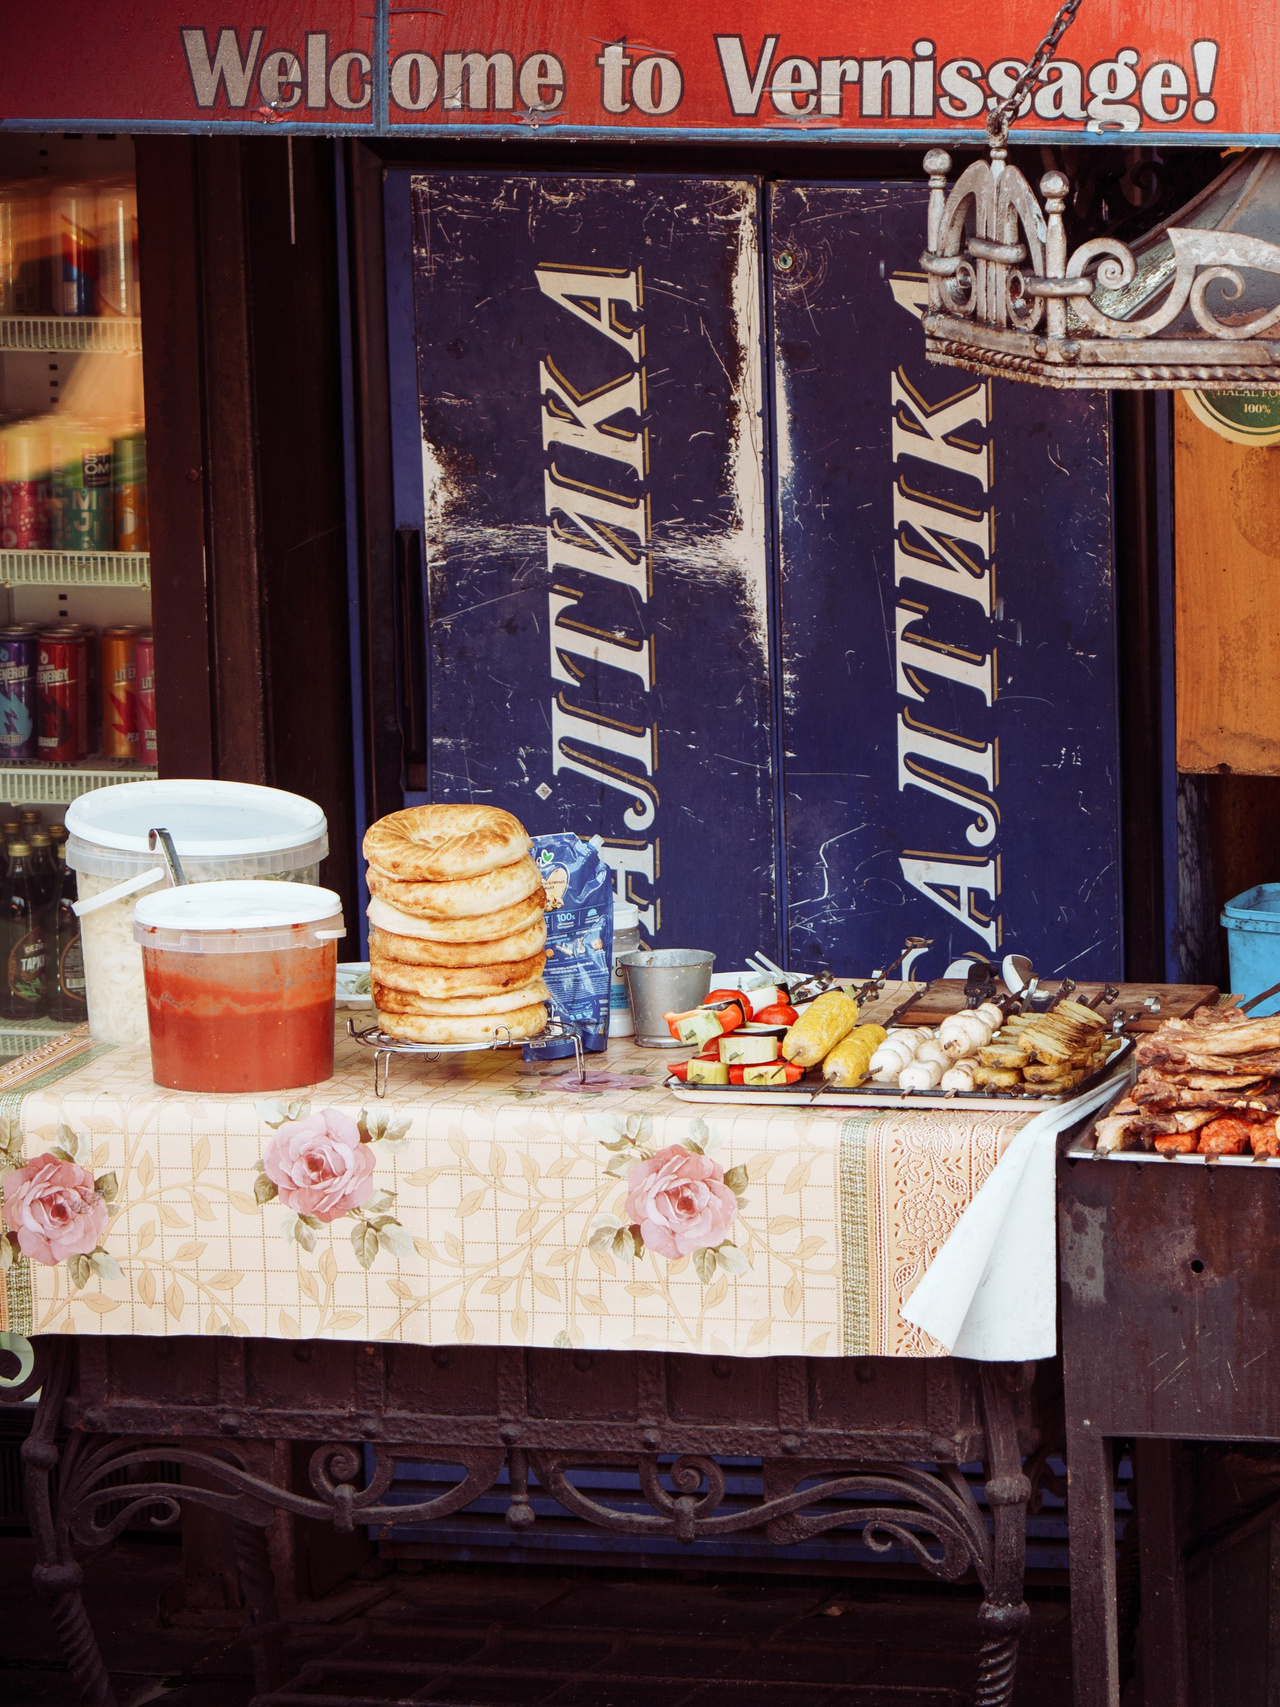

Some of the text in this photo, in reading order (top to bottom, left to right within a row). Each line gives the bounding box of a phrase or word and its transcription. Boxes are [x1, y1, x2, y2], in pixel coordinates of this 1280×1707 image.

[180, 27, 1219, 133] Welcome to Vernissage!
[1243, 403, 1271, 414] 100%
[888, 271, 1002, 981] АЛТИК
